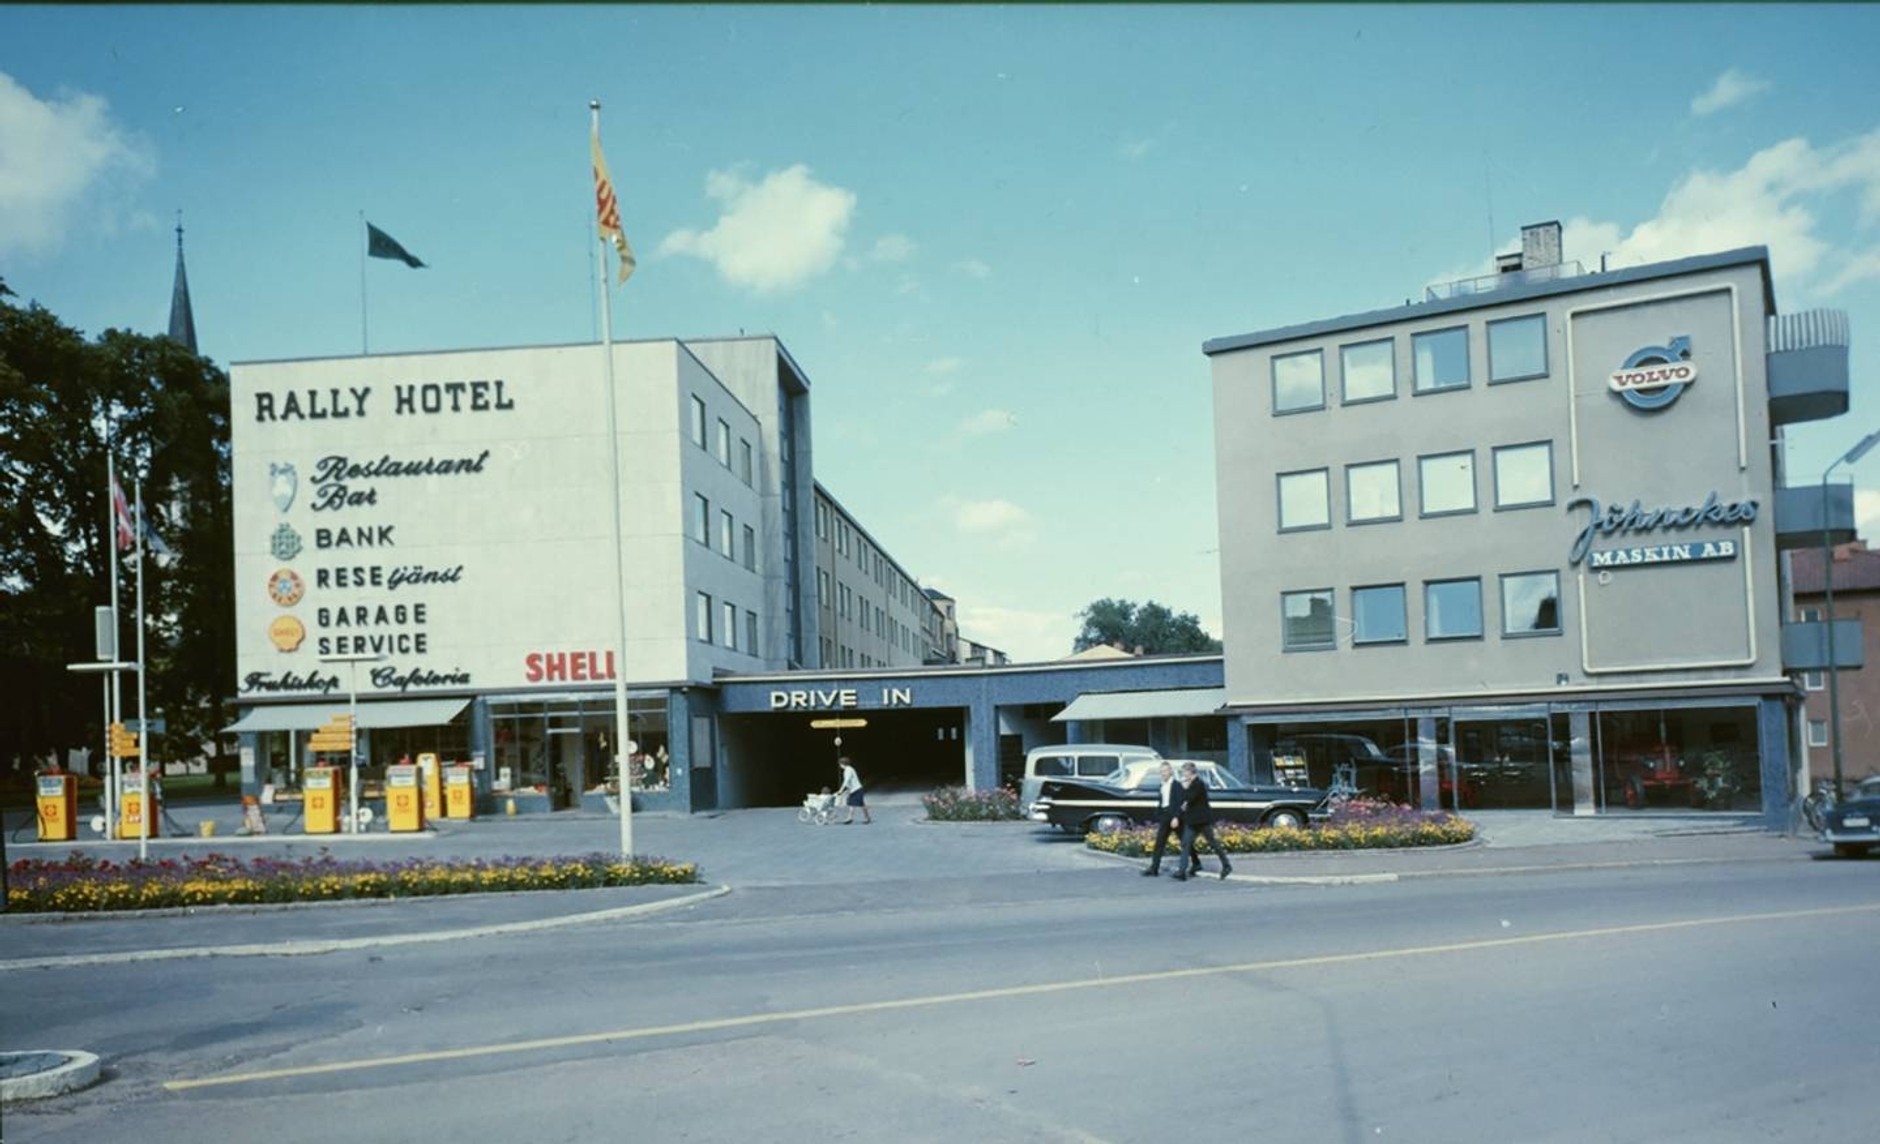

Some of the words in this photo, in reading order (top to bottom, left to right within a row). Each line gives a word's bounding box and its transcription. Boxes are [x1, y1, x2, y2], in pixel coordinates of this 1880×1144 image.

[1612, 366, 1691, 386] VOLVO
[255, 387, 371, 422] RALLY
[395, 380, 514, 415] HOTEL
[310, 450, 490, 484] Restaurant
[310, 483, 377, 511] Bar
[316, 525, 394, 549] BANK
[1568, 491, 1759, 566] Jöhnckes
[1592, 544, 1691, 566] MASKIN
[1701, 540, 1735, 558] AB
[318, 603, 426, 627] GARAGE
[318, 633, 427, 655] SERVICE
[371, 666, 470, 692] Cafeteria
[525, 650, 616, 682] SHELL
[770, 689, 857, 709] DRIVE
[883, 687, 912, 705] IN
